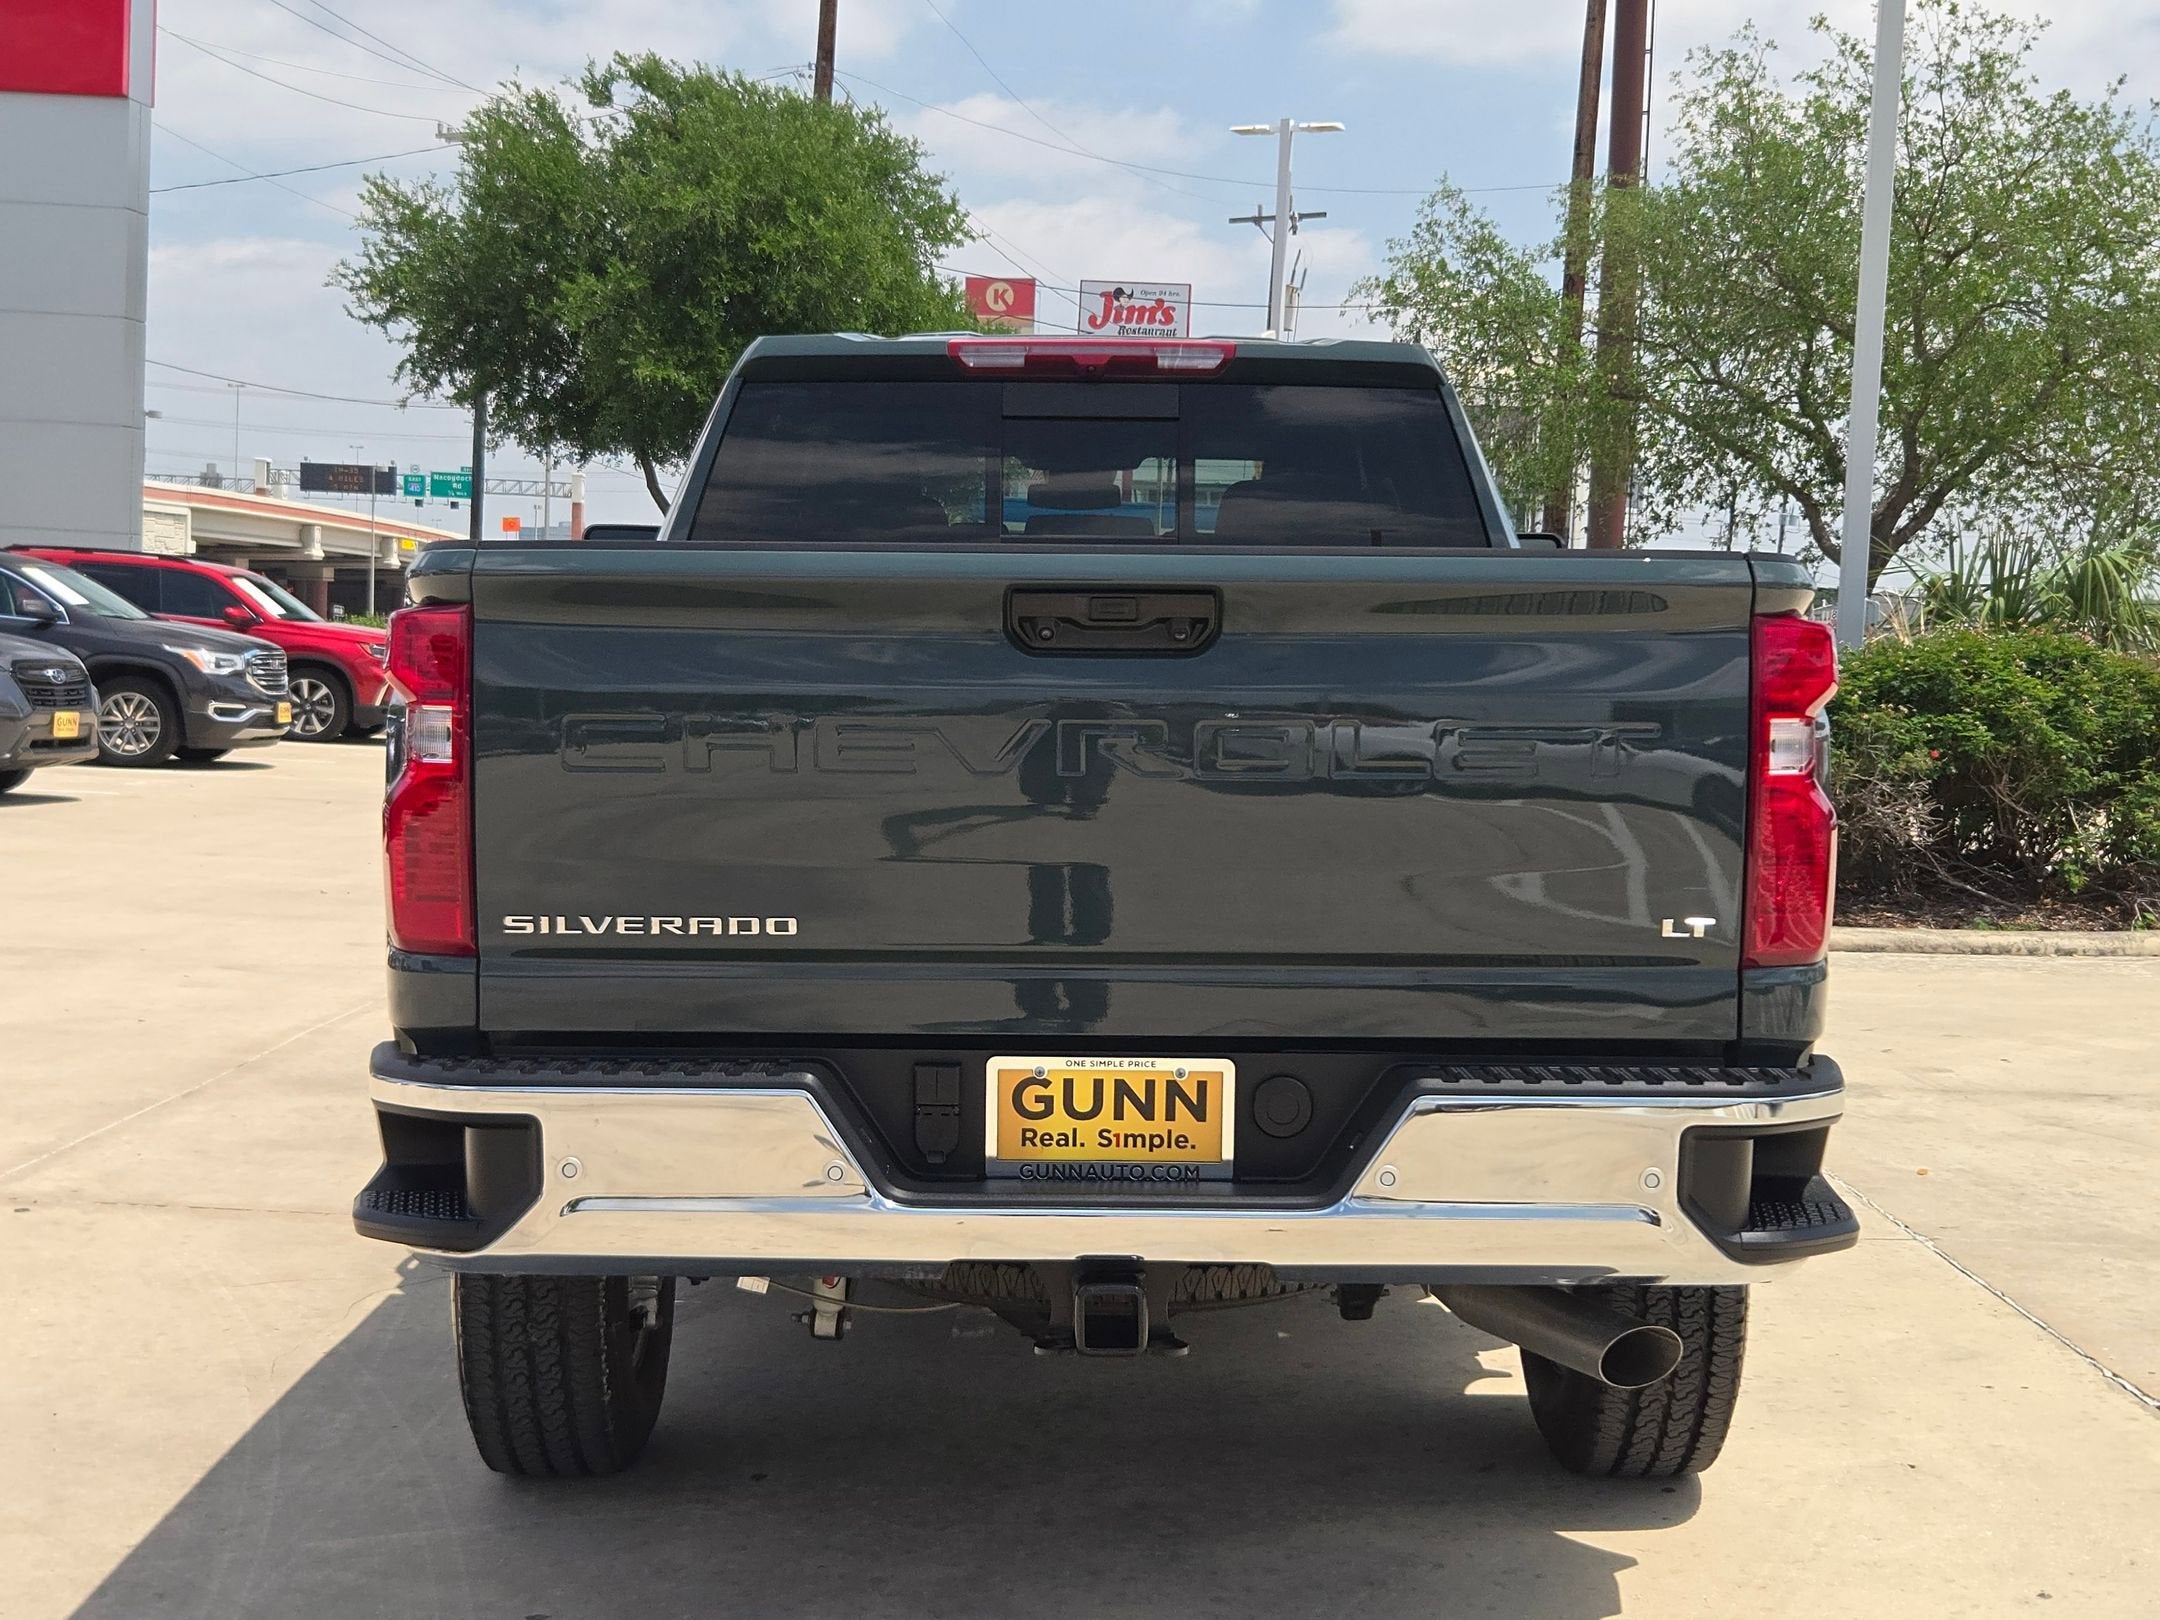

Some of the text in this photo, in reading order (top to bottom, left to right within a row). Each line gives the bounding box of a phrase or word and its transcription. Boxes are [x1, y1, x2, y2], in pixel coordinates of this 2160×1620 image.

[1140, 289, 1157, 297] Open
[1088, 290, 1176, 330] Jim's
[1117, 325, 1178, 337] Restaurant
[57, 717, 77, 727] GUNN
[561, 713, 1662, 781] CHEVROLET
[502, 915, 799, 936] SILVERADO
[1661, 916, 1717, 938] LT
[1065, 1059, 1157, 1068] ONE SIMPLE PRICE
[1011, 1076, 1208, 1123] GUNN
[1021, 1127, 1085, 1147] Real.
[1019, 1163, 1200, 1182] GUNNAUTO.COM
